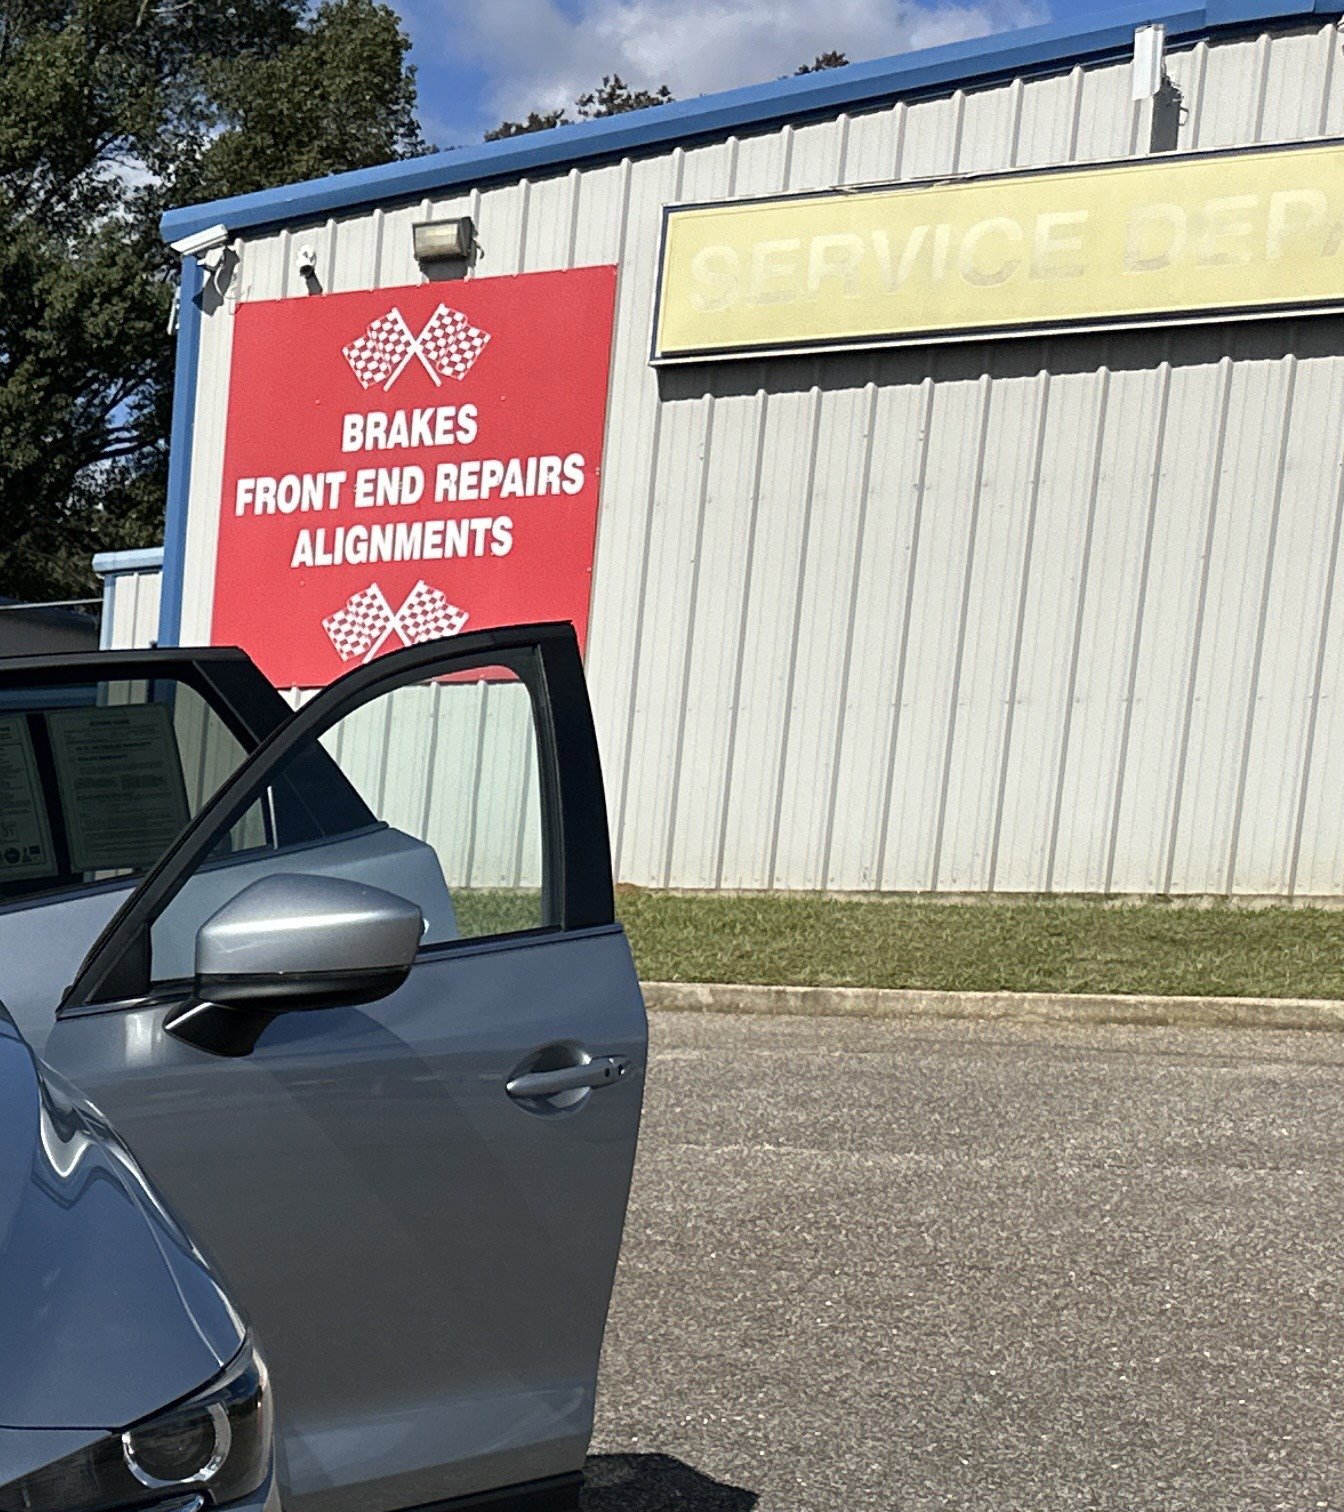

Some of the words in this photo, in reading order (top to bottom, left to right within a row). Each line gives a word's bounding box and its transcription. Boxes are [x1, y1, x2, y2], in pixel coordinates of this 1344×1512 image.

[689, 208, 1089, 313] SERVICE
[341, 403, 478, 453] BRAKES
[235, 470, 347, 517] FRONT
[354, 465, 425, 508] END
[434, 453, 586, 503] REPAIRS
[290, 515, 513, 569] ALIGNMENTS
